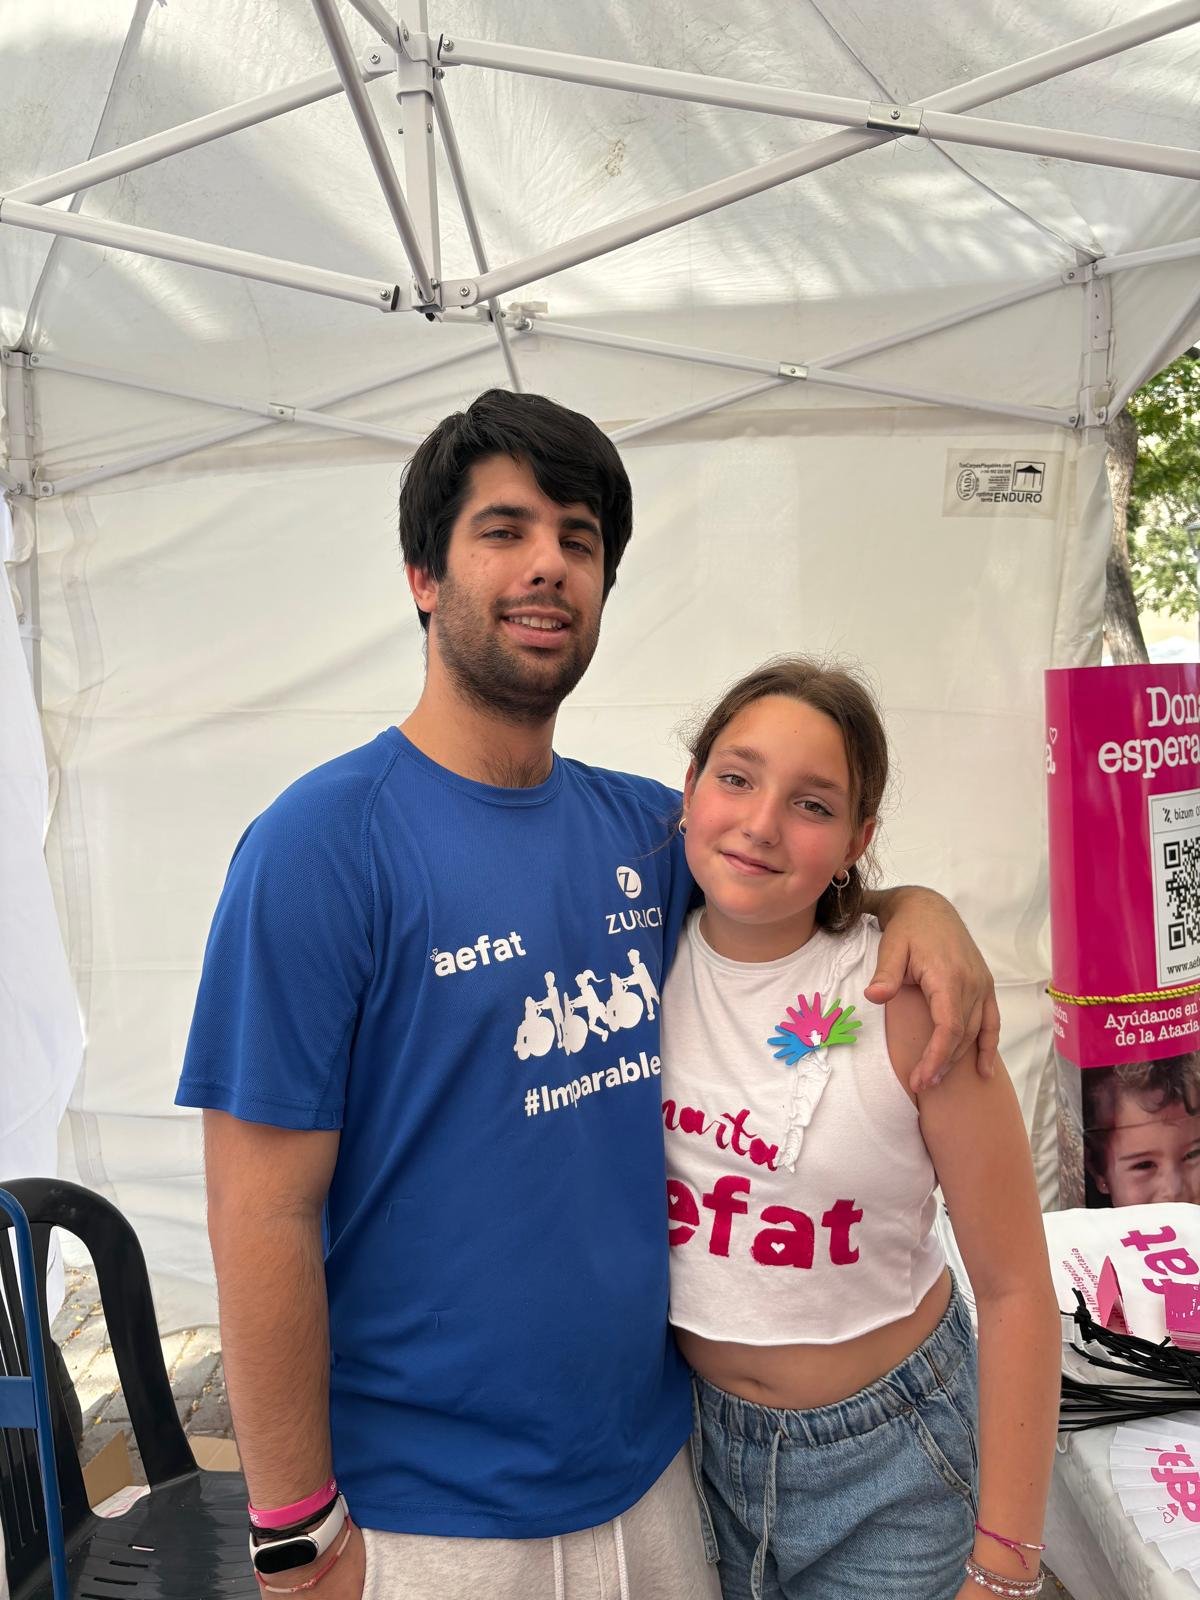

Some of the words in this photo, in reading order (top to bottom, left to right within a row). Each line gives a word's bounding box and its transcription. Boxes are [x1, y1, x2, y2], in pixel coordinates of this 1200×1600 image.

[994, 492, 1042, 503] ENDURO
[1146, 686, 1200, 727] Don
[1174, 808, 1194, 820] bizum
[434, 931, 526, 977] aefat
[1104, 1008, 1182, 1030] Ayúdanos
[1185, 1002, 1198, 1016] en
[1115, 1030, 1136, 1046] de
[1139, 1029, 1155, 1044] la
[1157, 1018, 1200, 1041] Ataxia
[666, 1175, 863, 1270] efat
